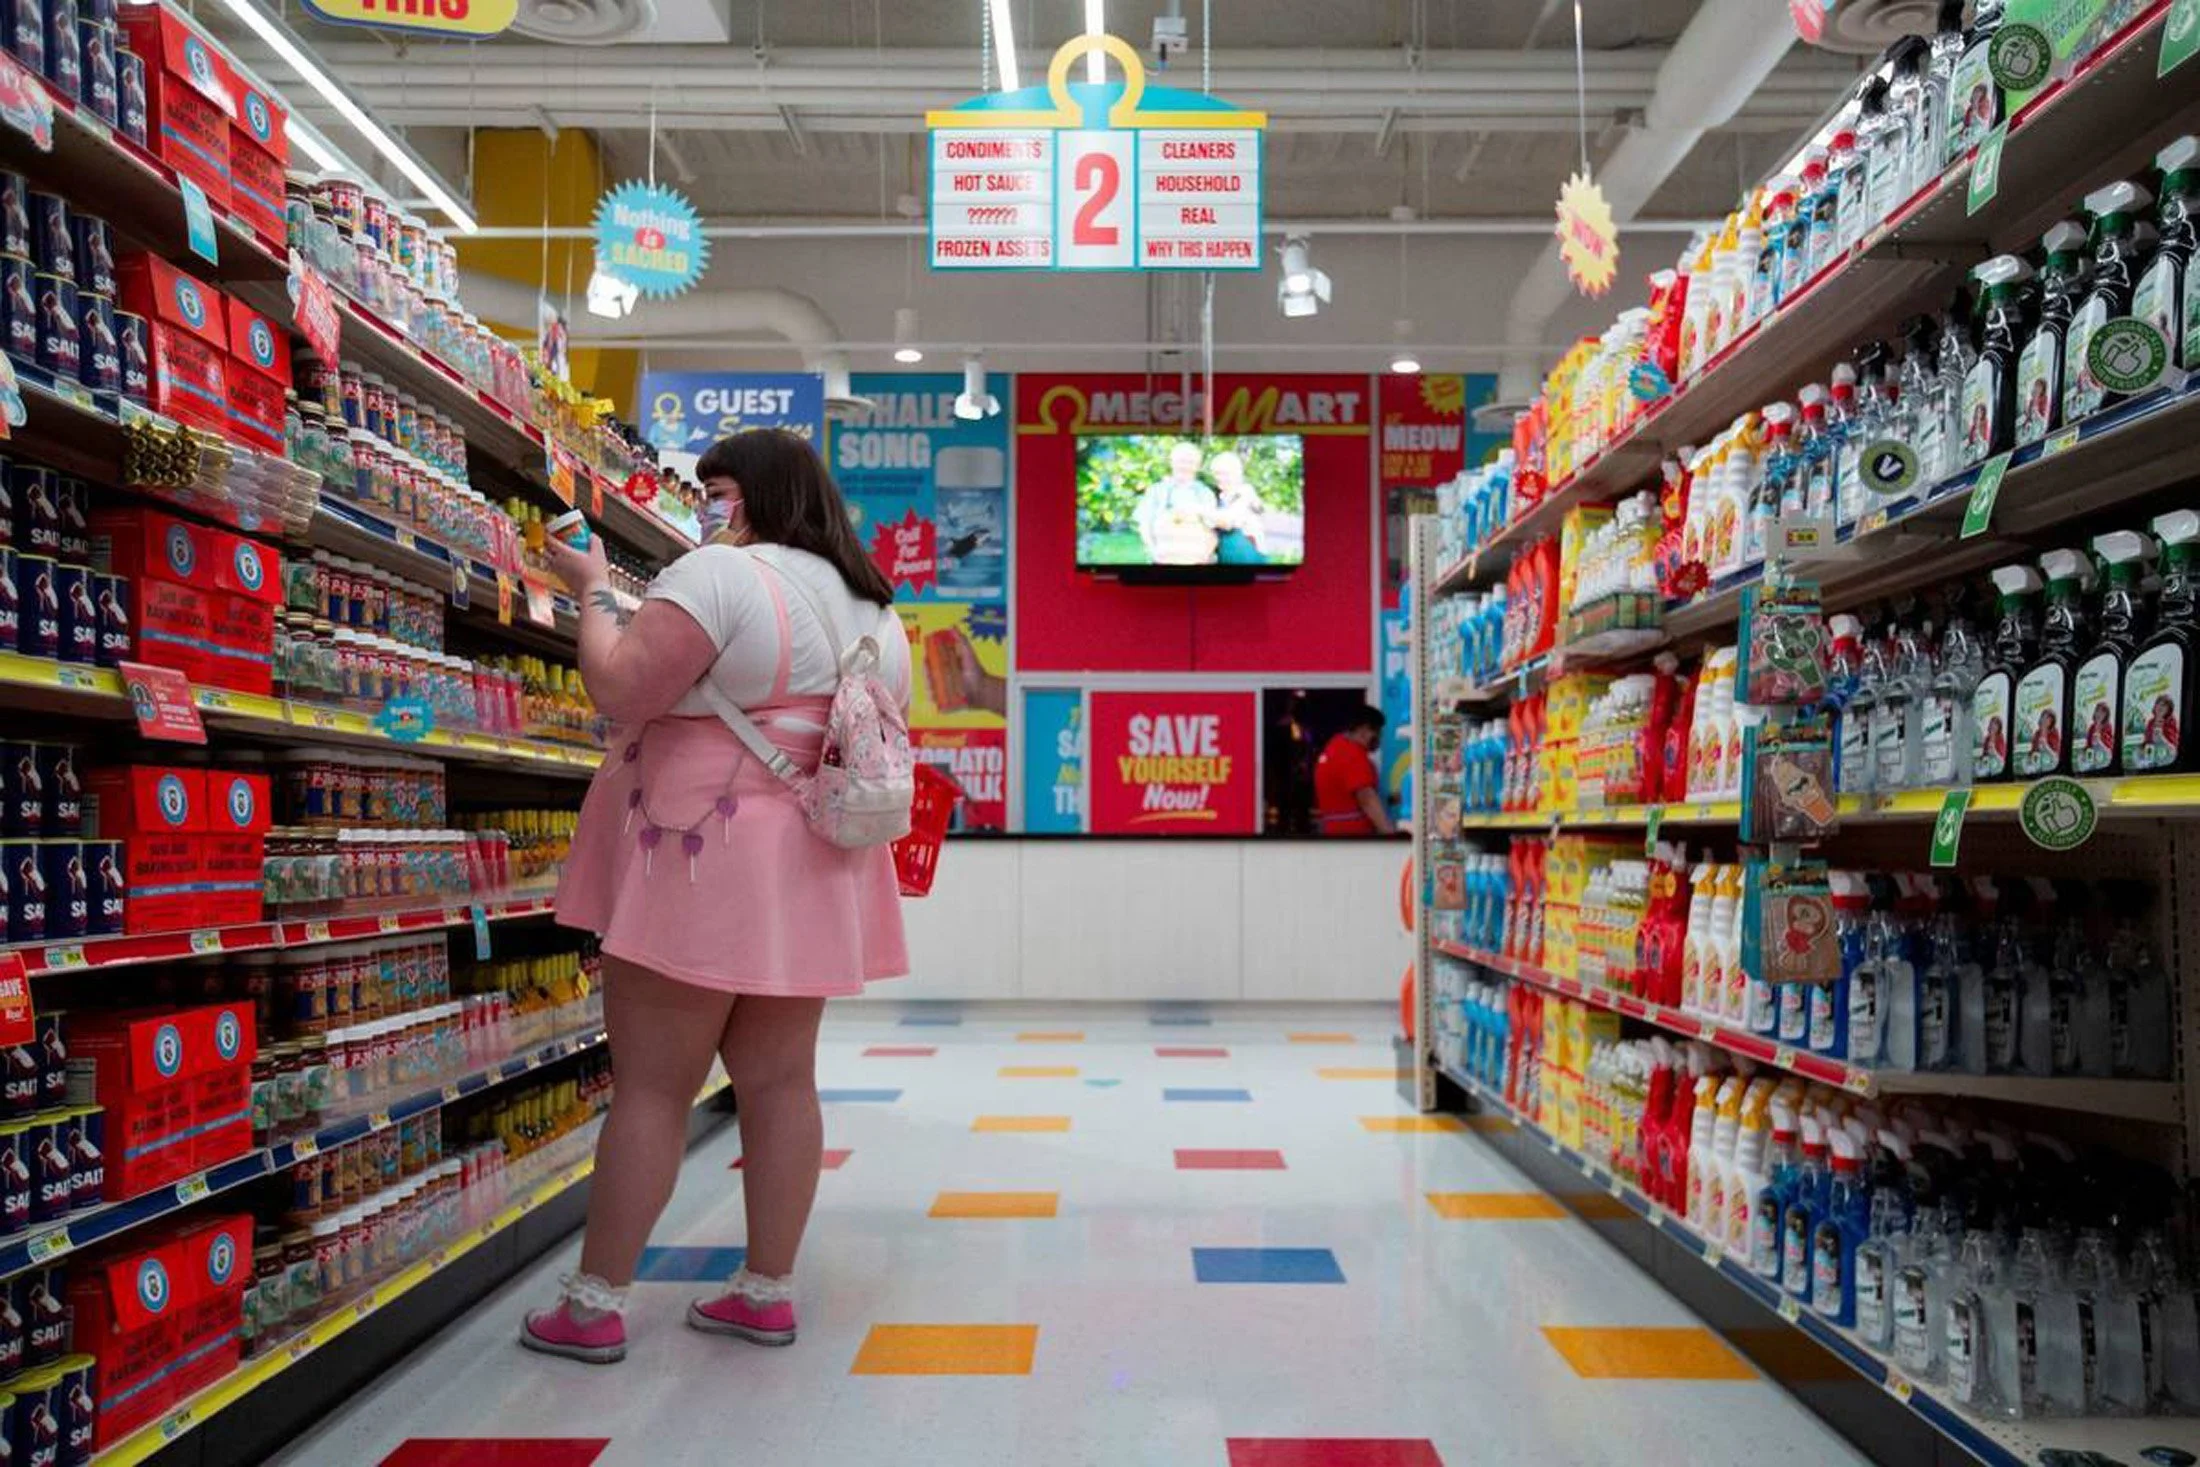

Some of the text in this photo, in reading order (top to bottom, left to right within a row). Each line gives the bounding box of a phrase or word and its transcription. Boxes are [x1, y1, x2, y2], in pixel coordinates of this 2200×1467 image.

[1163, 142, 1236, 159] CLEANERS
[954, 175, 982, 191] HOT
[1156, 175, 1241, 192] HOUSEHOLD
[1073, 153, 1120, 246] 2
[1181, 207, 1217, 224] REAL
[936, 241, 990, 257] FROZEN
[1146, 240, 1252, 258] WHY THIS HAPPEN
[694, 389, 794, 415] GUEST
[1384, 424, 1461, 450] MEOW
[838, 432, 931, 470] SONG
[1128, 714, 1220, 757] SAVE
[1118, 756, 1232, 784] YOURSELF
[1143, 783, 1211, 811] Now!
